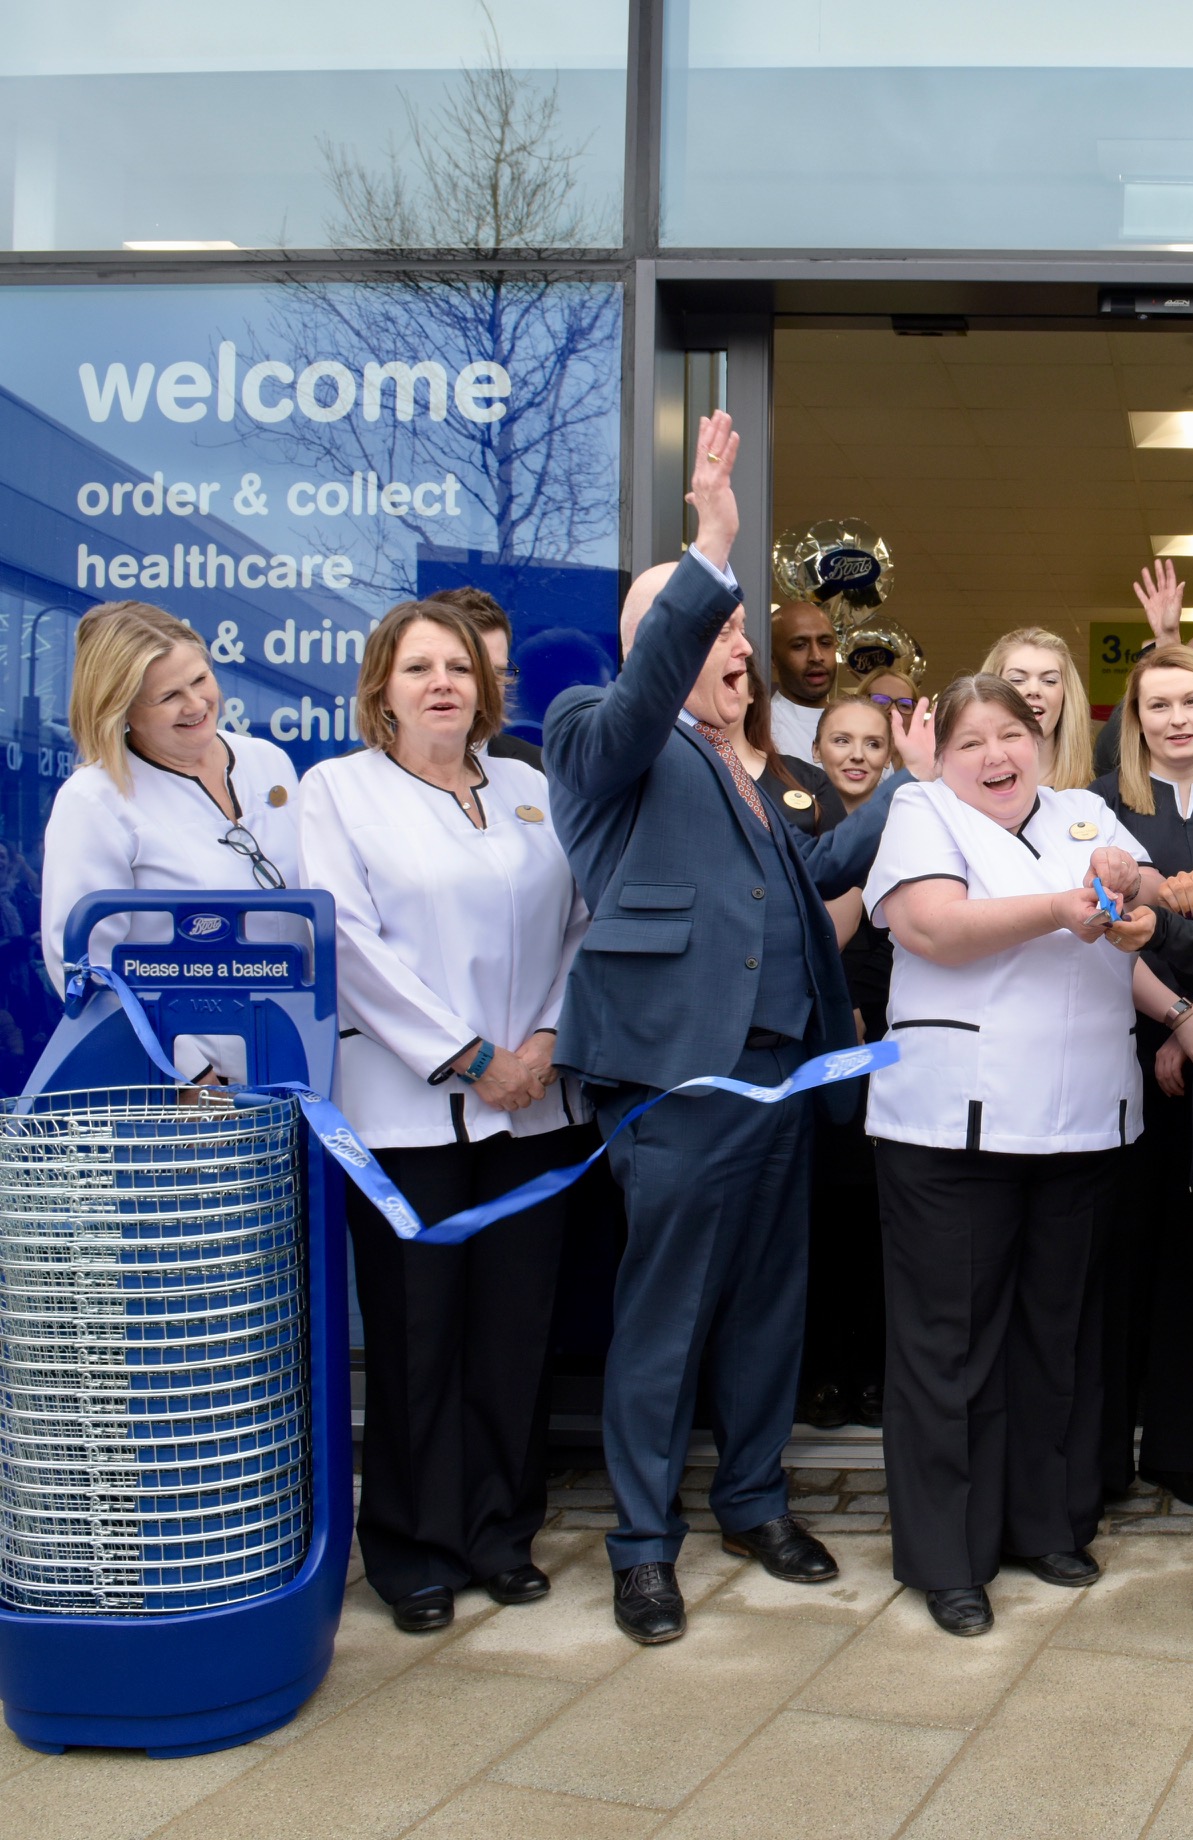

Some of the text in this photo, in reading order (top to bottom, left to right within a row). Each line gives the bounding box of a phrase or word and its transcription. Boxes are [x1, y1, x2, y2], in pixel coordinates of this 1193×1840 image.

[79, 340, 512, 423] welcome
[77, 471, 462, 516] order & collect
[77, 543, 354, 589] healthcare
[825, 555, 874, 582] Boots
[210, 620, 246, 664] &
[1103, 635, 1121, 664] 3
[270, 696, 359, 742] chil
[189, 917, 222, 936] Boots
[124, 960, 289, 977] Please use a basket
[320, 1127, 371, 1168] Boots
